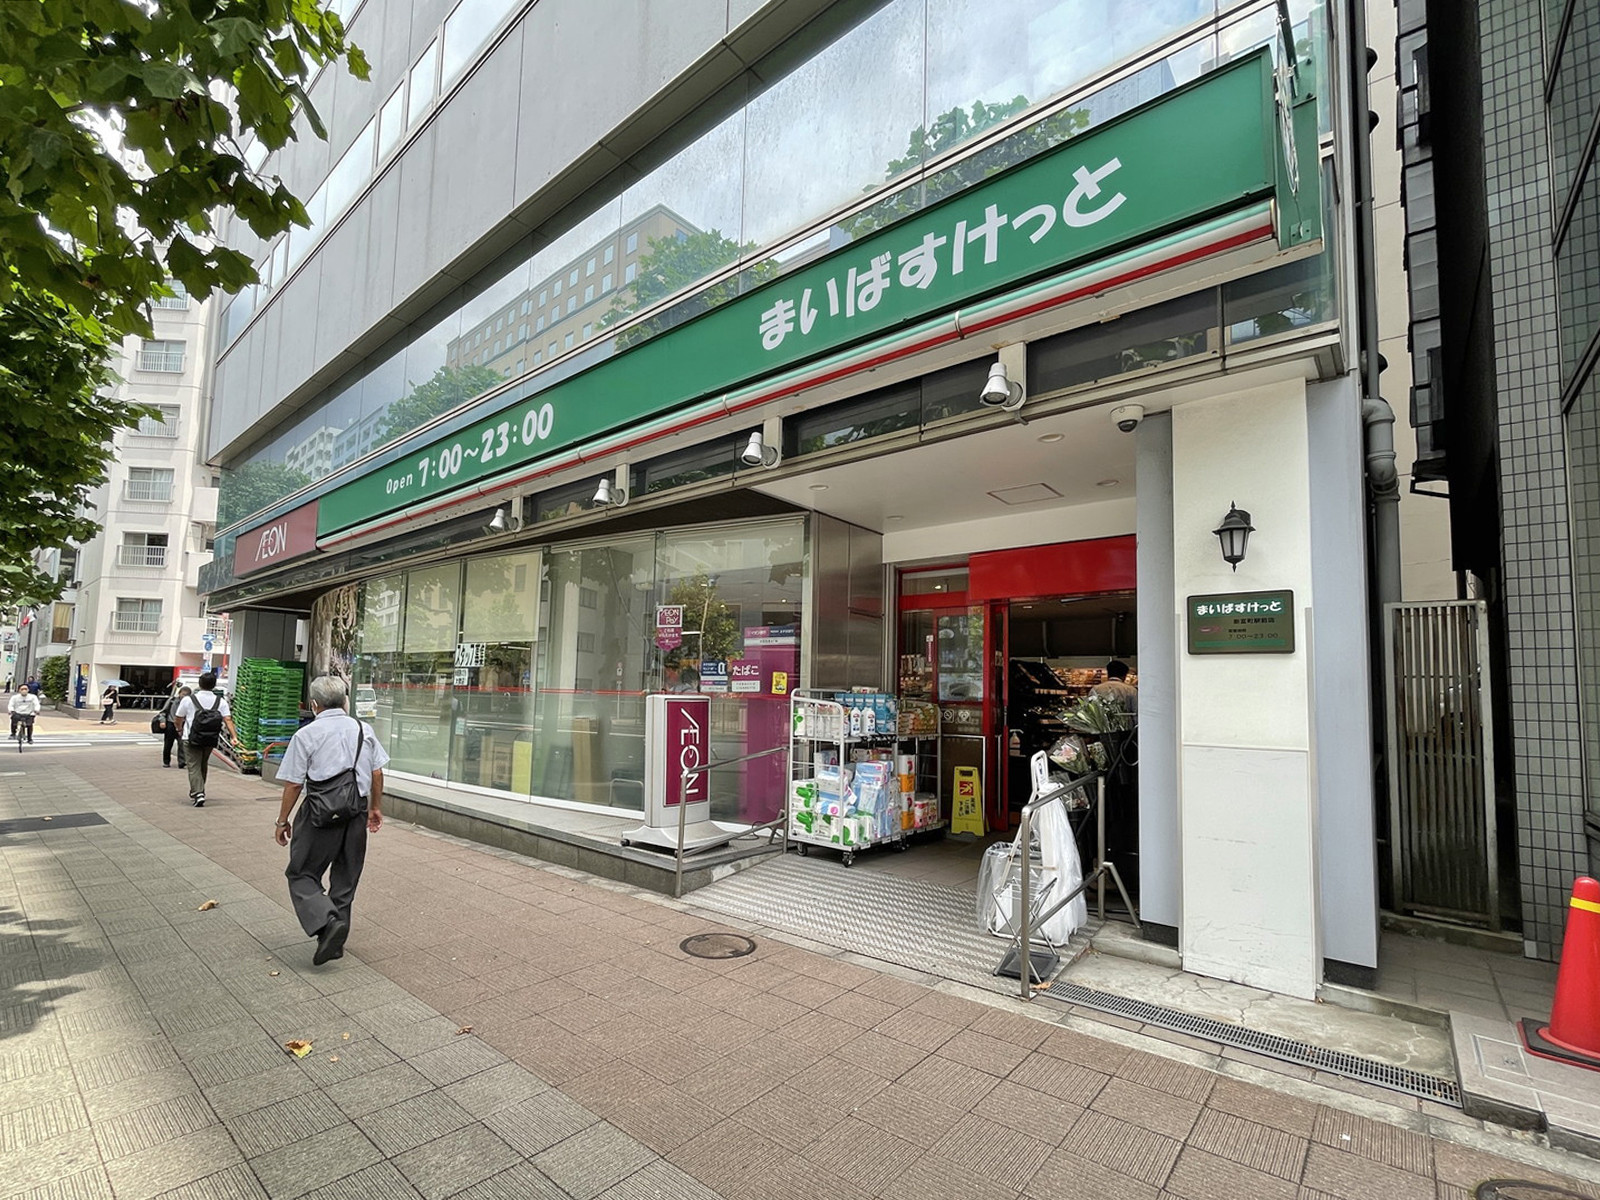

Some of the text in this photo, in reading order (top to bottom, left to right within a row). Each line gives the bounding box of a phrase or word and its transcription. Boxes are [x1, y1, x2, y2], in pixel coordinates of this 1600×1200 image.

[759, 157, 1127, 351] まいばすけっと
[386, 474, 413, 495] Open
[1196, 601, 1282, 615] まいばすけっと
[732, 665, 760, 676] たばこ
